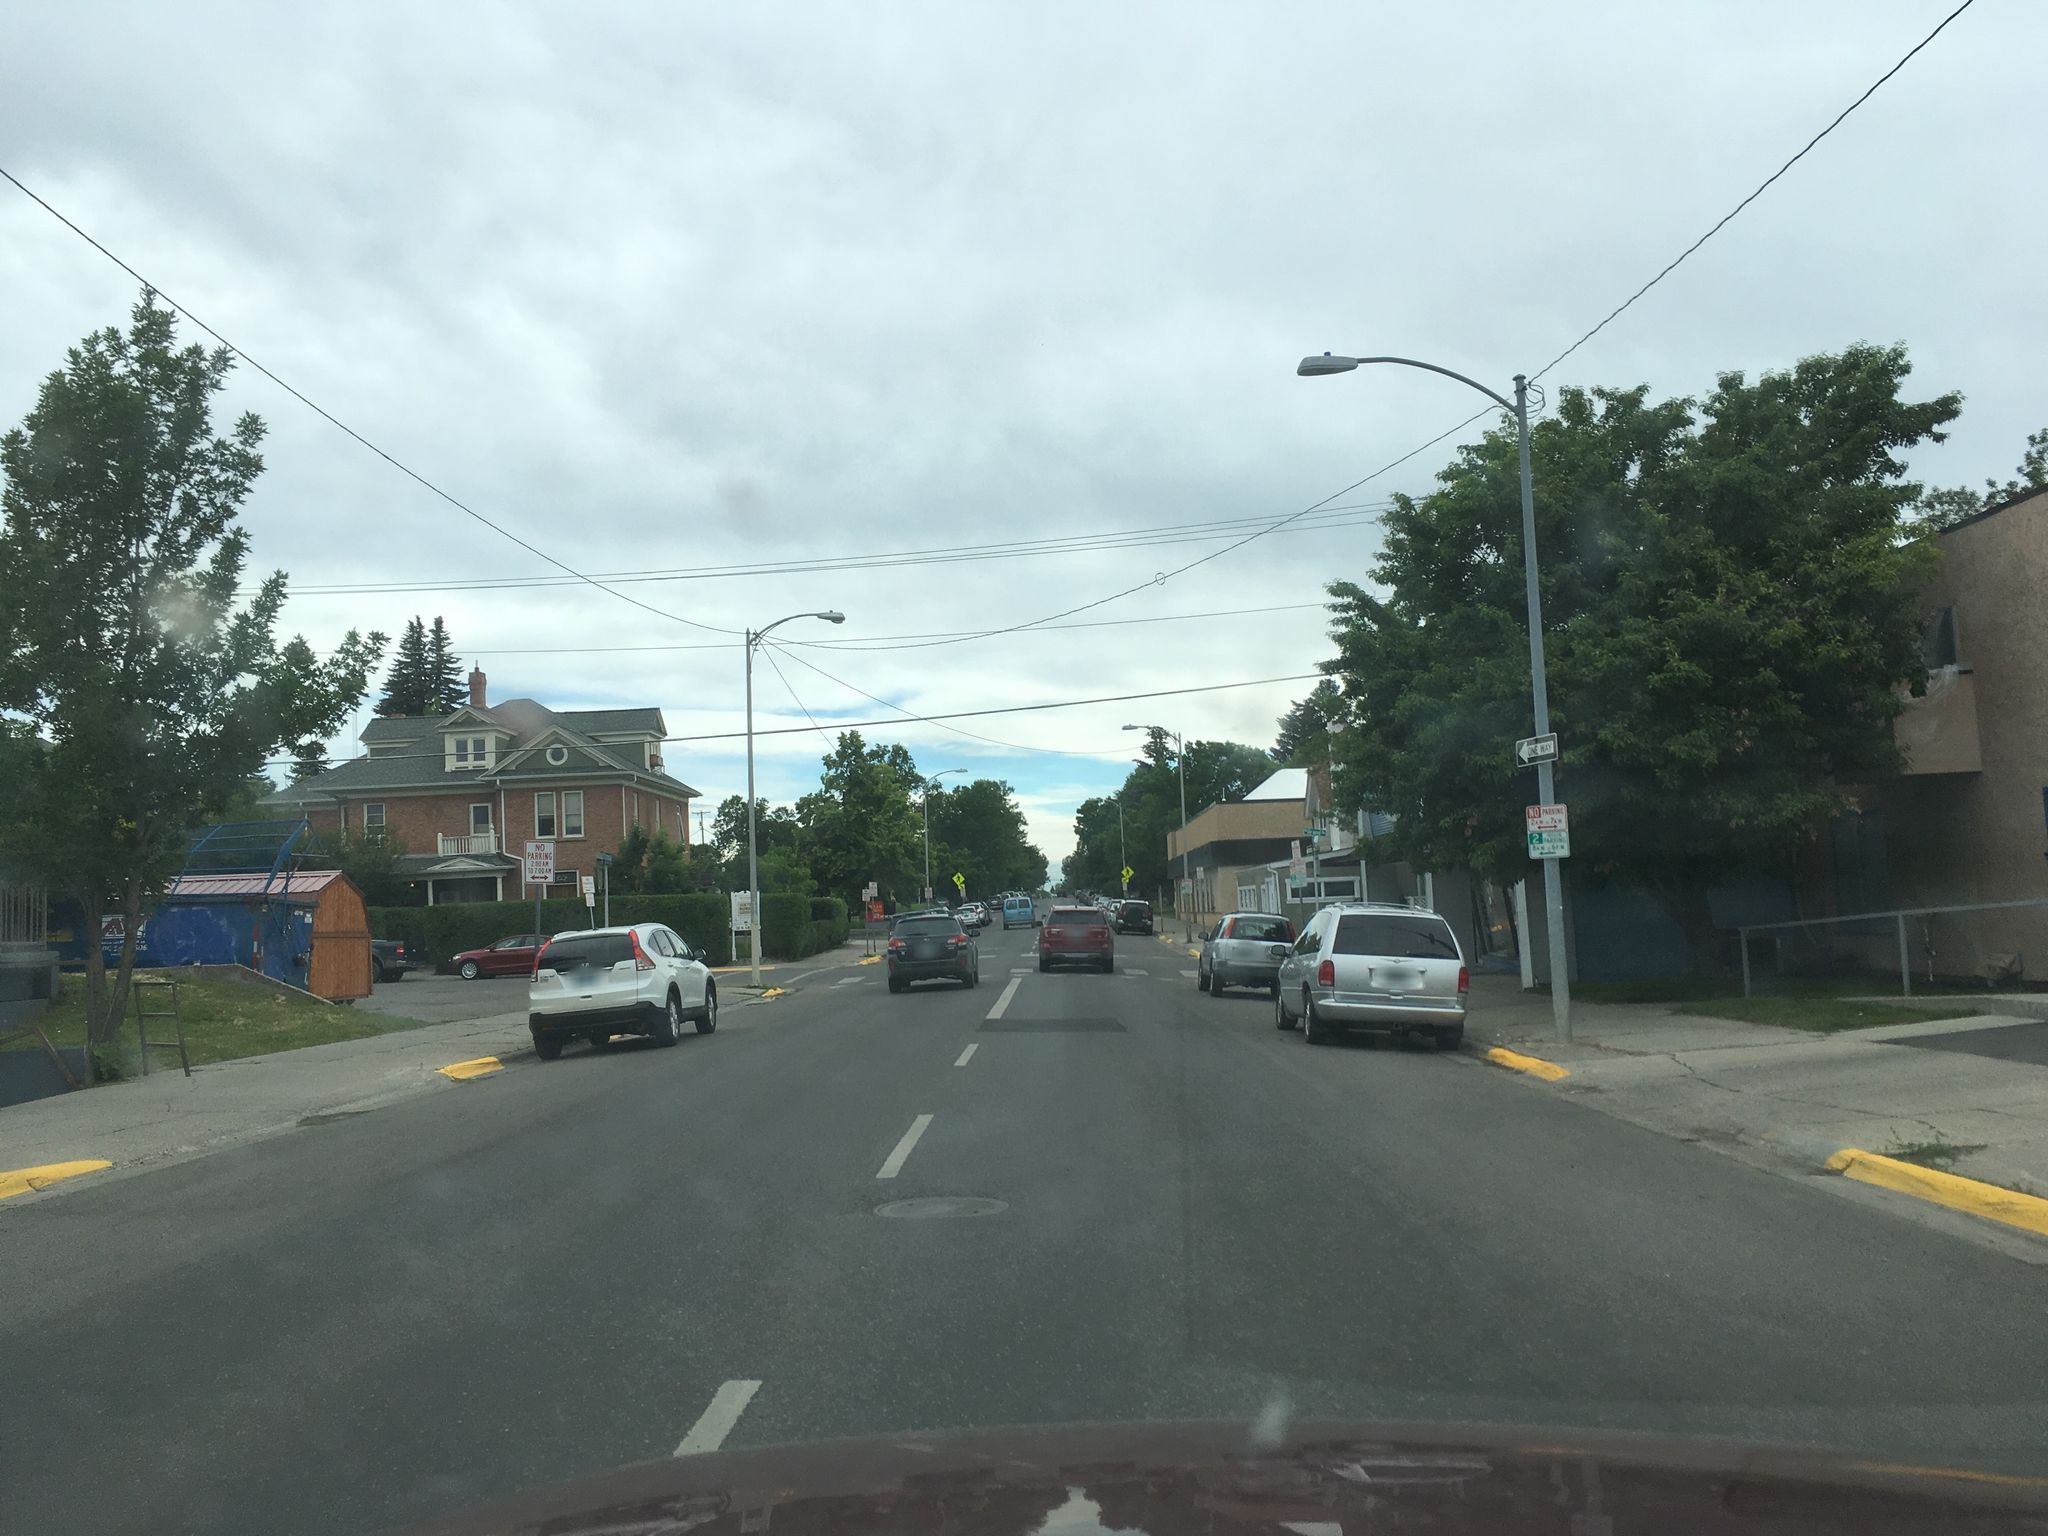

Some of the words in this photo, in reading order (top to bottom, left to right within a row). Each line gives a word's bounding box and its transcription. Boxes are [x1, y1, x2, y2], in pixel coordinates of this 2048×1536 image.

[1528, 744, 1539, 756] ONE
[1540, 743, 1552, 753] WAY
[1528, 807, 1540, 818] NO
[1541, 806, 1564, 816] PARKING
[1532, 833, 1540, 844] 2
[535, 844, 545, 852] NO
[527, 852, 553, 861] PARKING
[527, 867, 534, 875] TO
